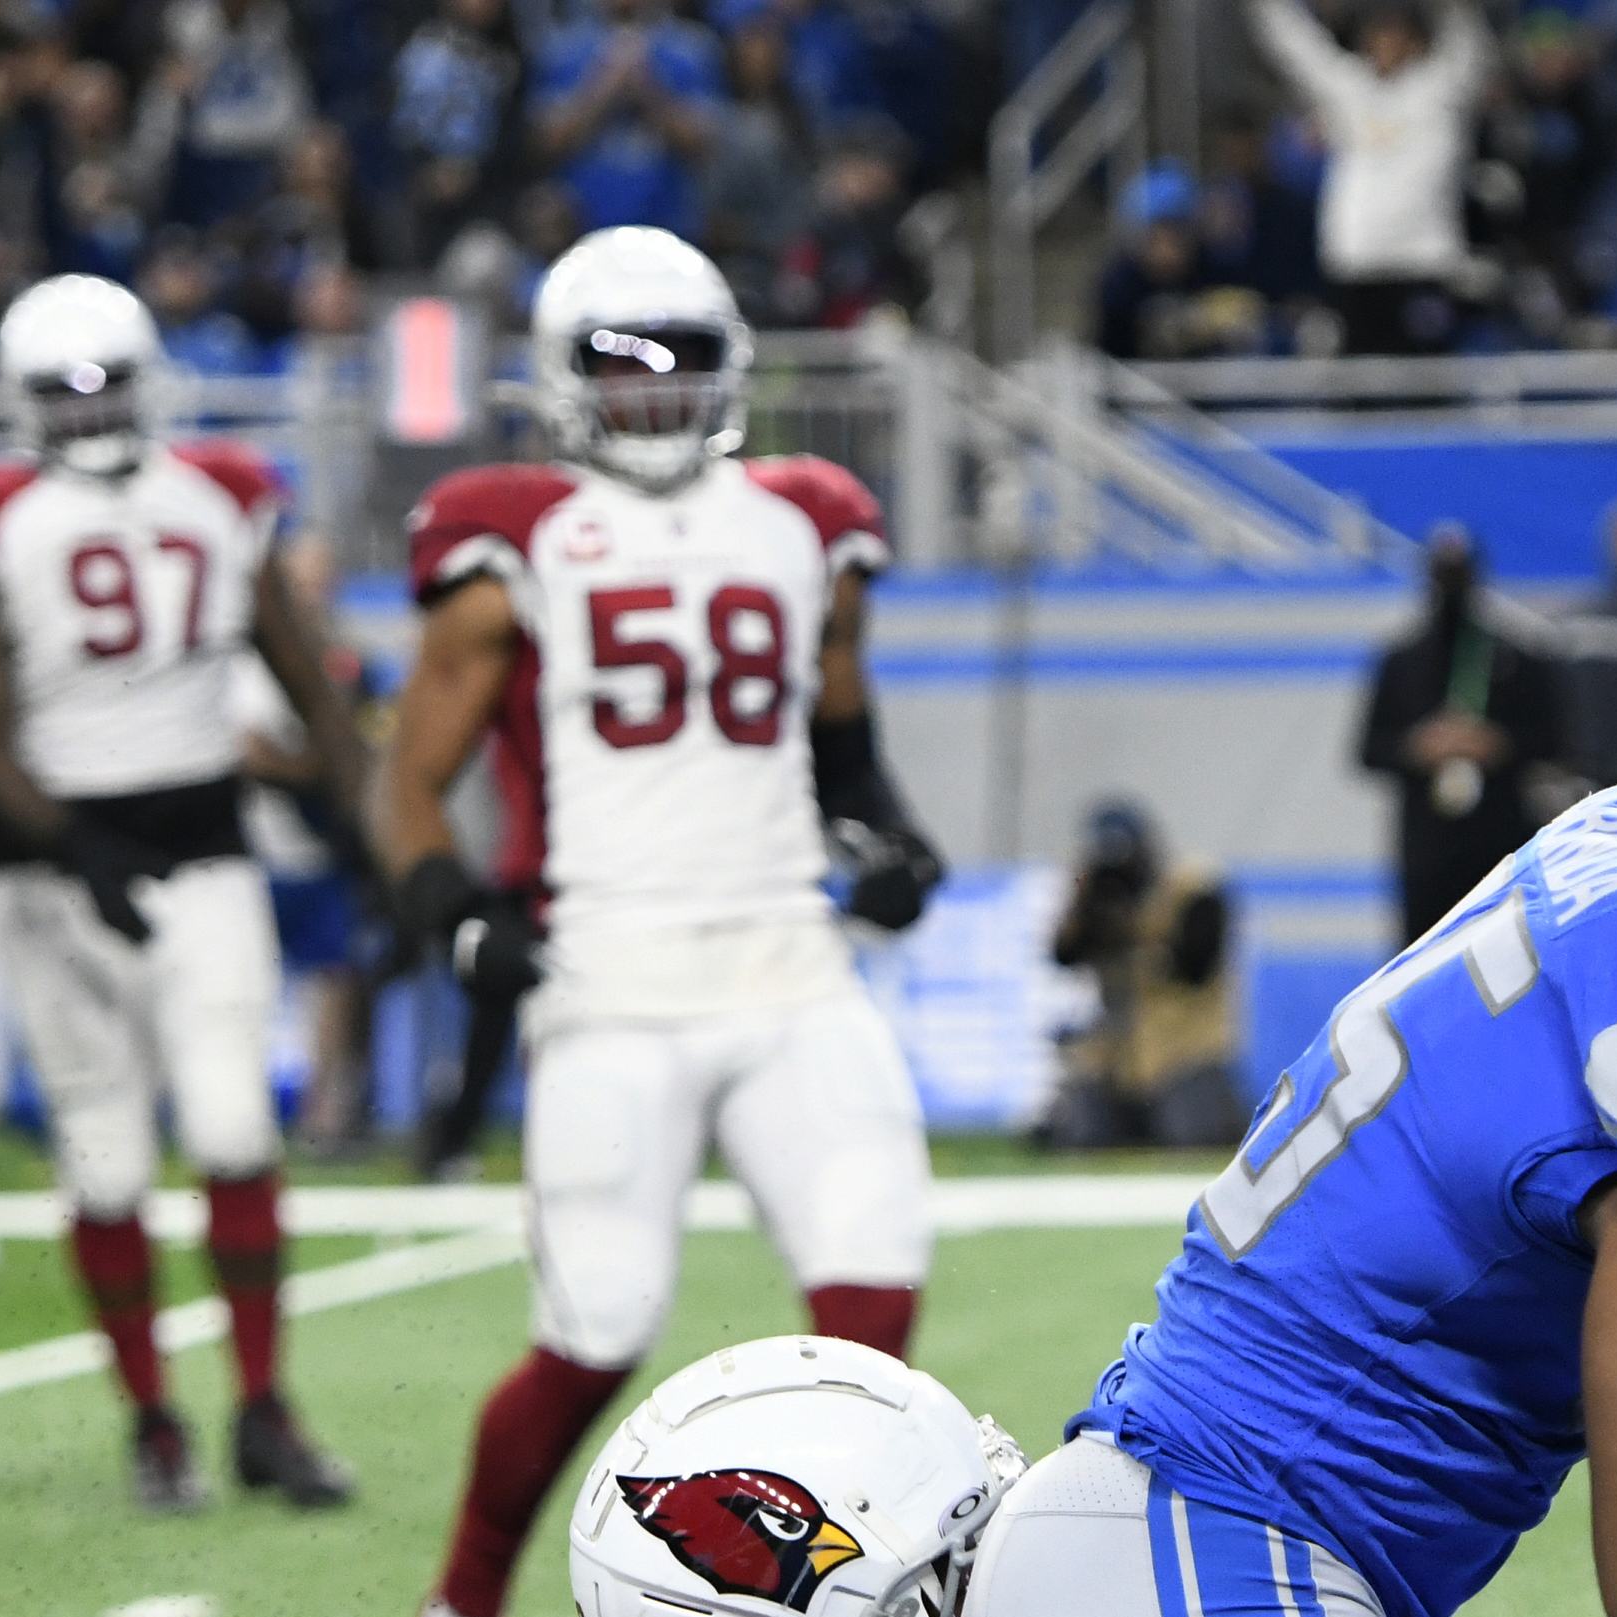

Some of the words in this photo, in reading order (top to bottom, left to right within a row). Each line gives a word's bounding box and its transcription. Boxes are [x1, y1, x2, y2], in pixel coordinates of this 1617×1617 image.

[66, 530, 209, 657] 97
[587, 582, 786, 749] 58
[1198, 855, 1541, 1263] 5
